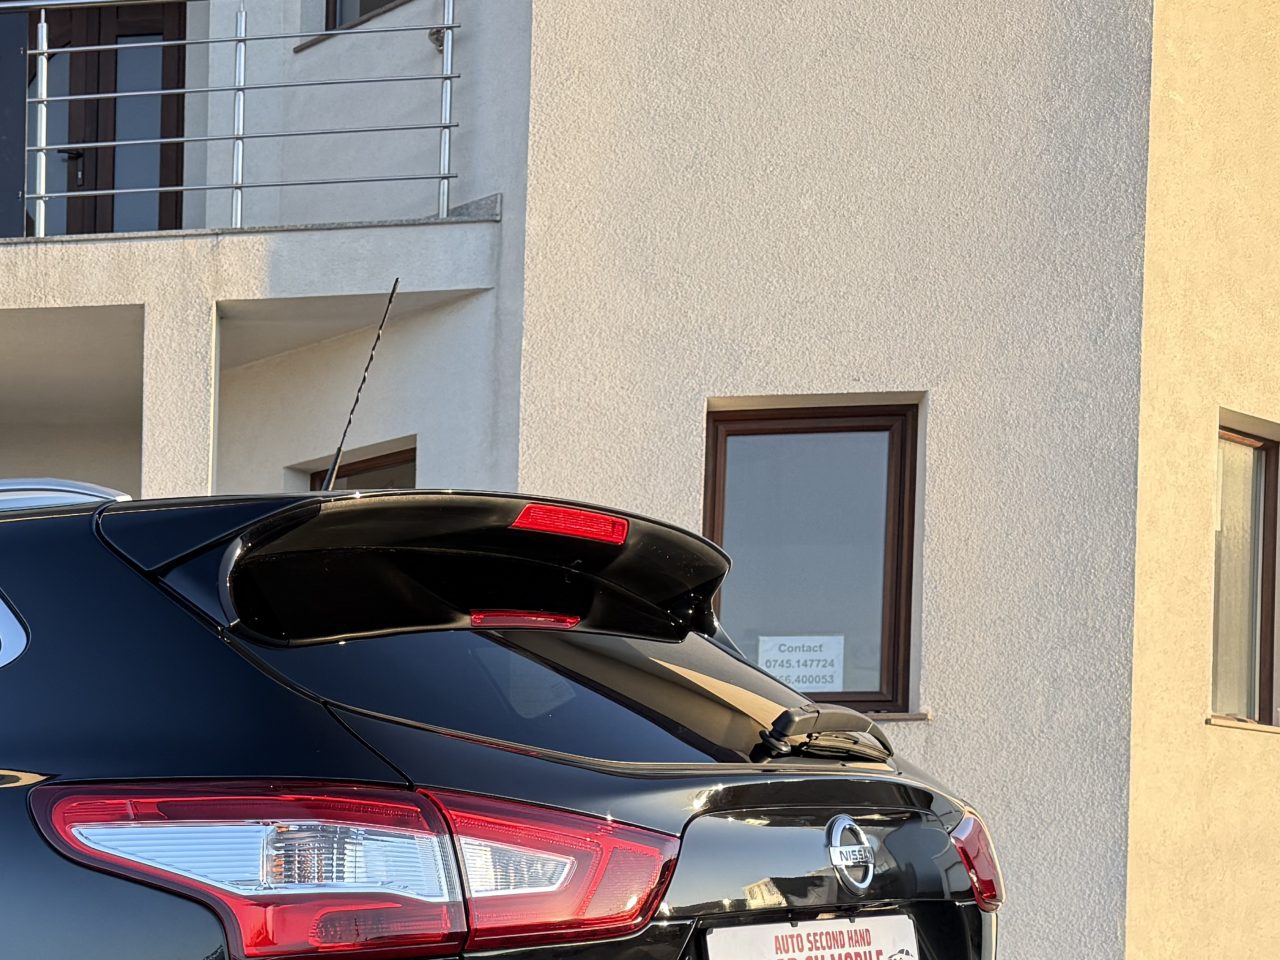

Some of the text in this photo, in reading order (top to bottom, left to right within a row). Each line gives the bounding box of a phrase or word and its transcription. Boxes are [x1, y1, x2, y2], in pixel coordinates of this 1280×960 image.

[778, 643, 823, 653] Contact
[765, 659, 834, 669] 0745.147724
[839, 850, 873, 862] NISSAN
[774, 928, 872, 955] AUTO SECOND HAND
